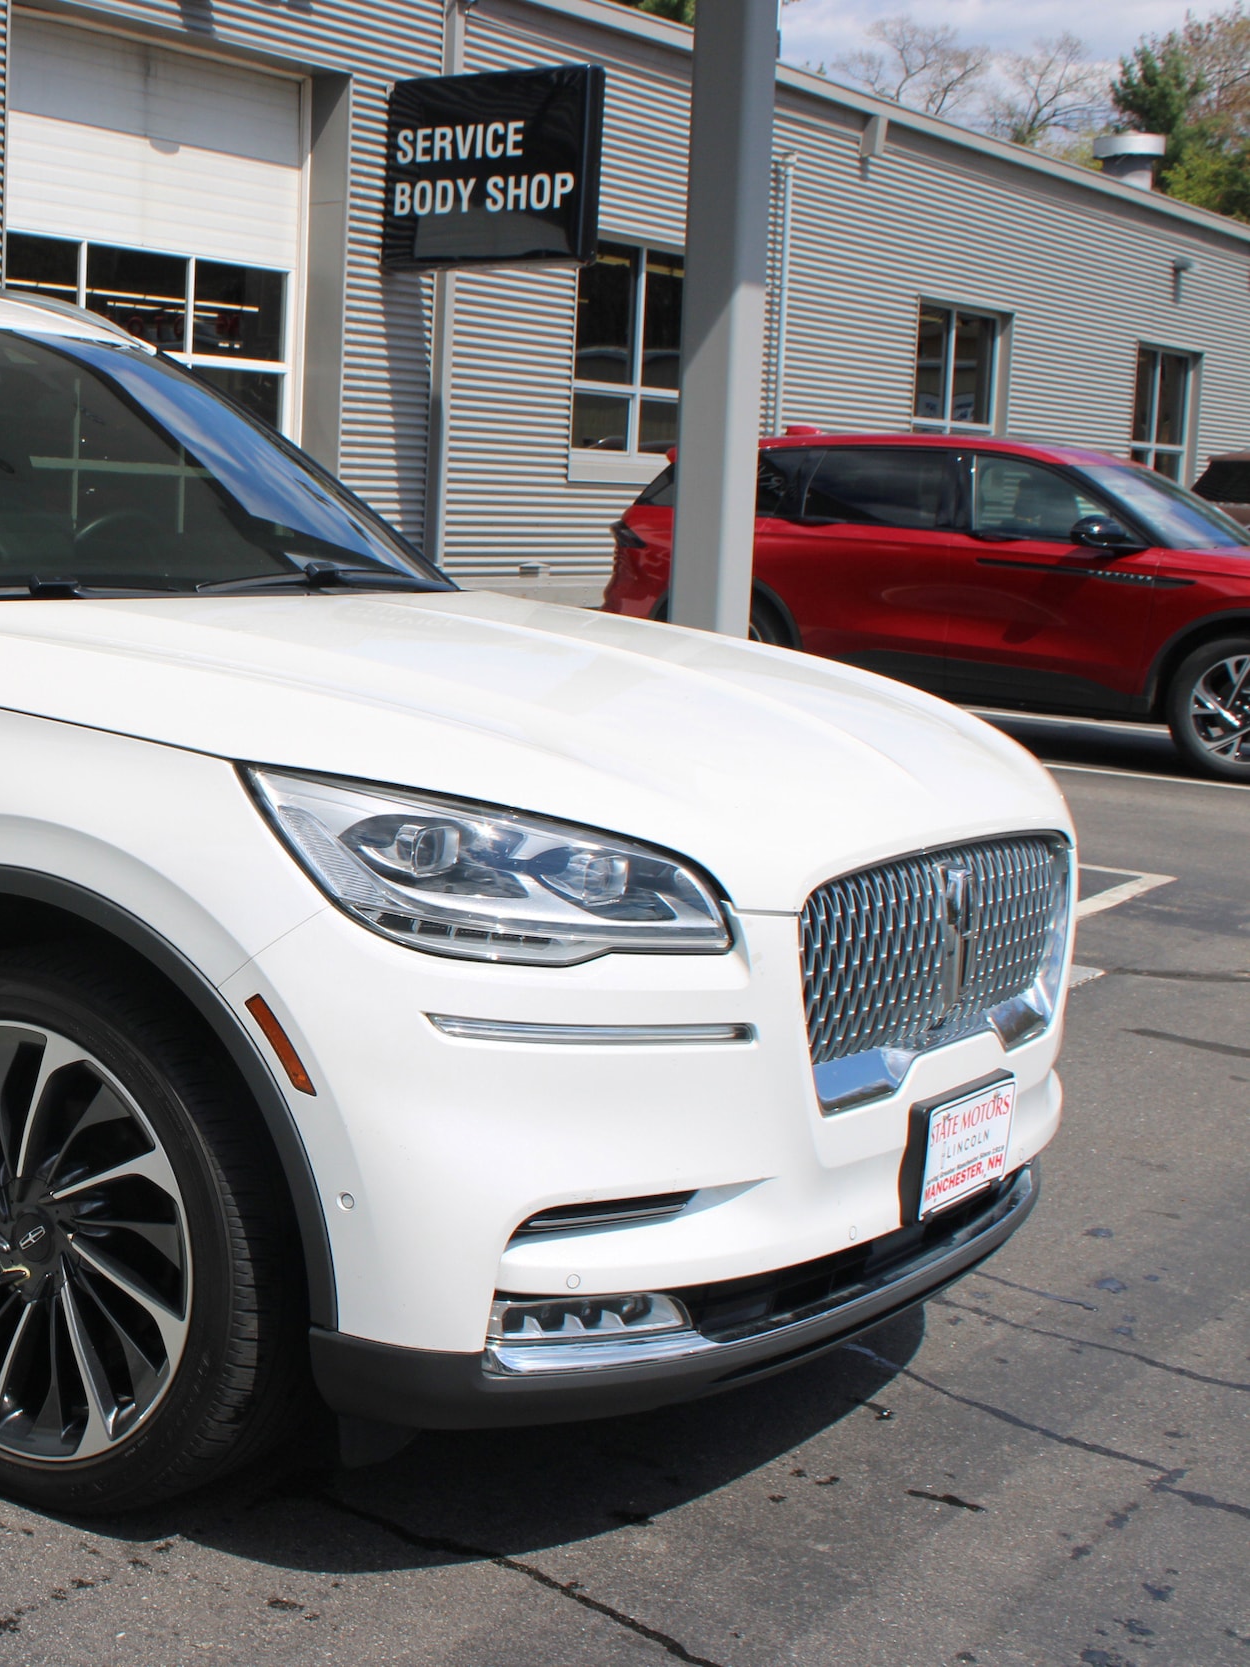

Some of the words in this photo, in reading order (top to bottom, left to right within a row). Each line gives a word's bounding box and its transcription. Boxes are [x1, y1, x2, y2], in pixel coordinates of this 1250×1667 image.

[396, 121, 525, 164] SERVICE
[393, 177, 477, 216] BODY
[485, 172, 575, 212] SHOP
[930, 1114, 959, 1148] STATE
[961, 1095, 1011, 1130] MOTORS
[946, 1129, 989, 1158] LINCOLN
[924, 1161, 985, 1202] MANCHESTER,
[988, 1153, 1003, 1170] NH
